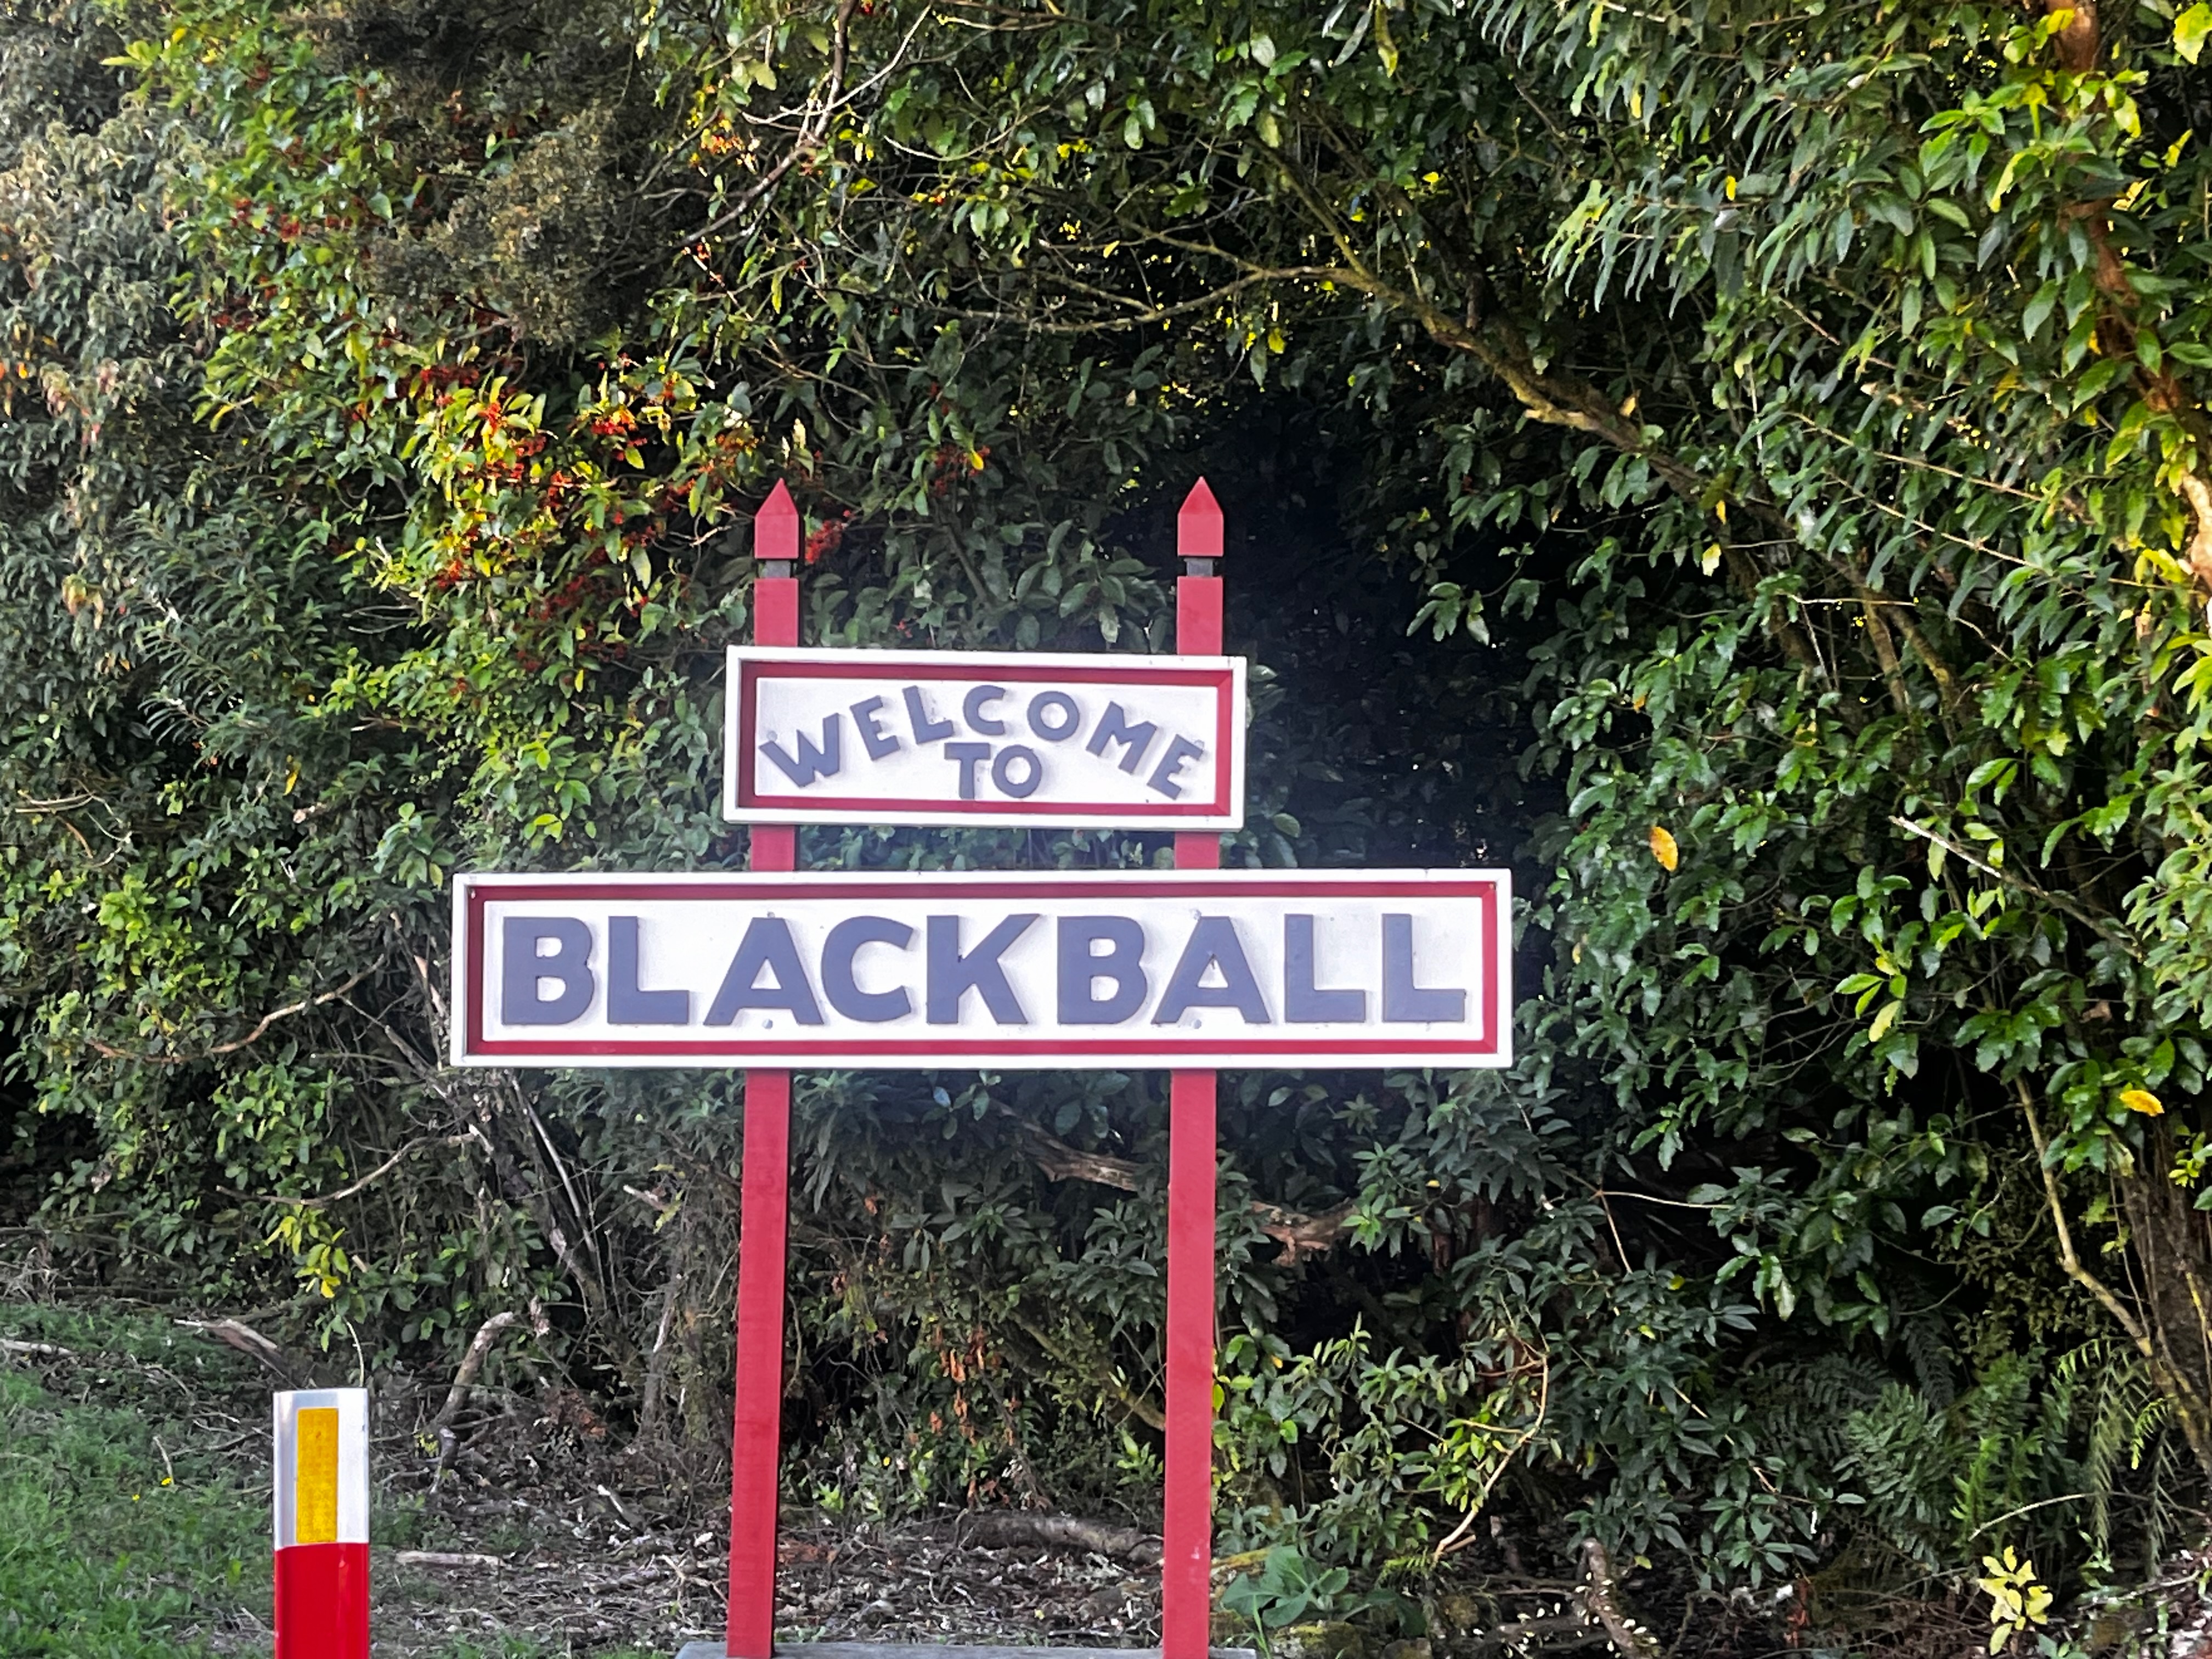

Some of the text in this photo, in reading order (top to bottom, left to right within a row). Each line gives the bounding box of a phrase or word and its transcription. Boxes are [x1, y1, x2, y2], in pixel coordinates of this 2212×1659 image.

[759, 685, 1205, 800] WELCOME
[944, 742, 1043, 799] TO
[501, 913, 1466, 1025] BLACKBALL
